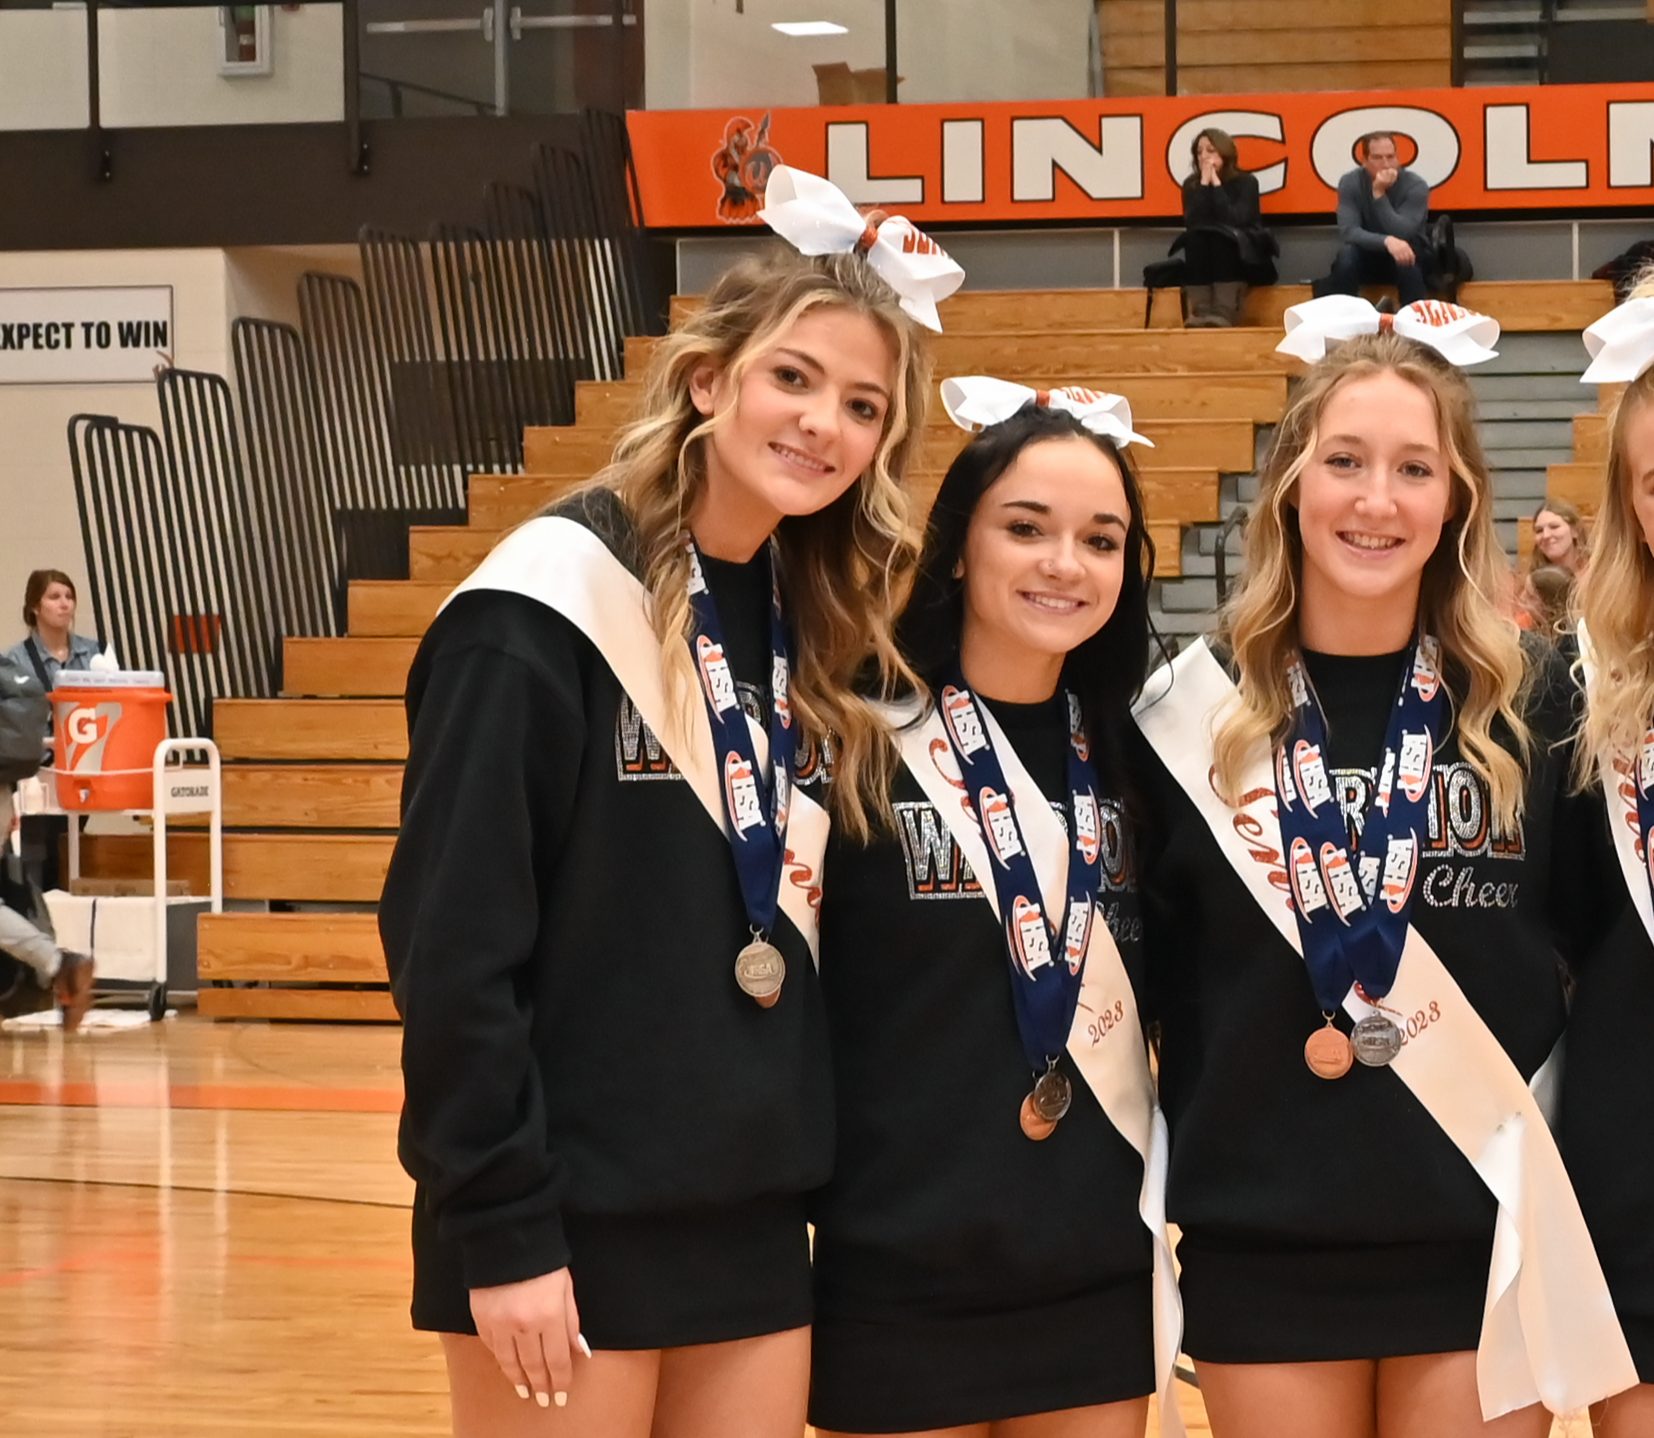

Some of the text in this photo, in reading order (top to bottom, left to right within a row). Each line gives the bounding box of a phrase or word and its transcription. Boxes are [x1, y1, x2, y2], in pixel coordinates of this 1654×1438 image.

[0, 320, 168, 351] XPECT TO WIN
[699, 643, 738, 713] IHSA
[949, 690, 986, 754] IHSA
[170, 785, 209, 798] GATORADE
[1297, 744, 1332, 809] IHSA
[1397, 734, 1427, 790] IHSA
[727, 760, 763, 830] IHSA
[983, 793, 1022, 860] IHSA
[1293, 846, 1329, 913] IHSA
[1322, 848, 1364, 916] IHSA
[1380, 838, 1413, 901] IHSA
[1016, 903, 1052, 970] IHSA
[1086, 1000, 1124, 1047] 2023
